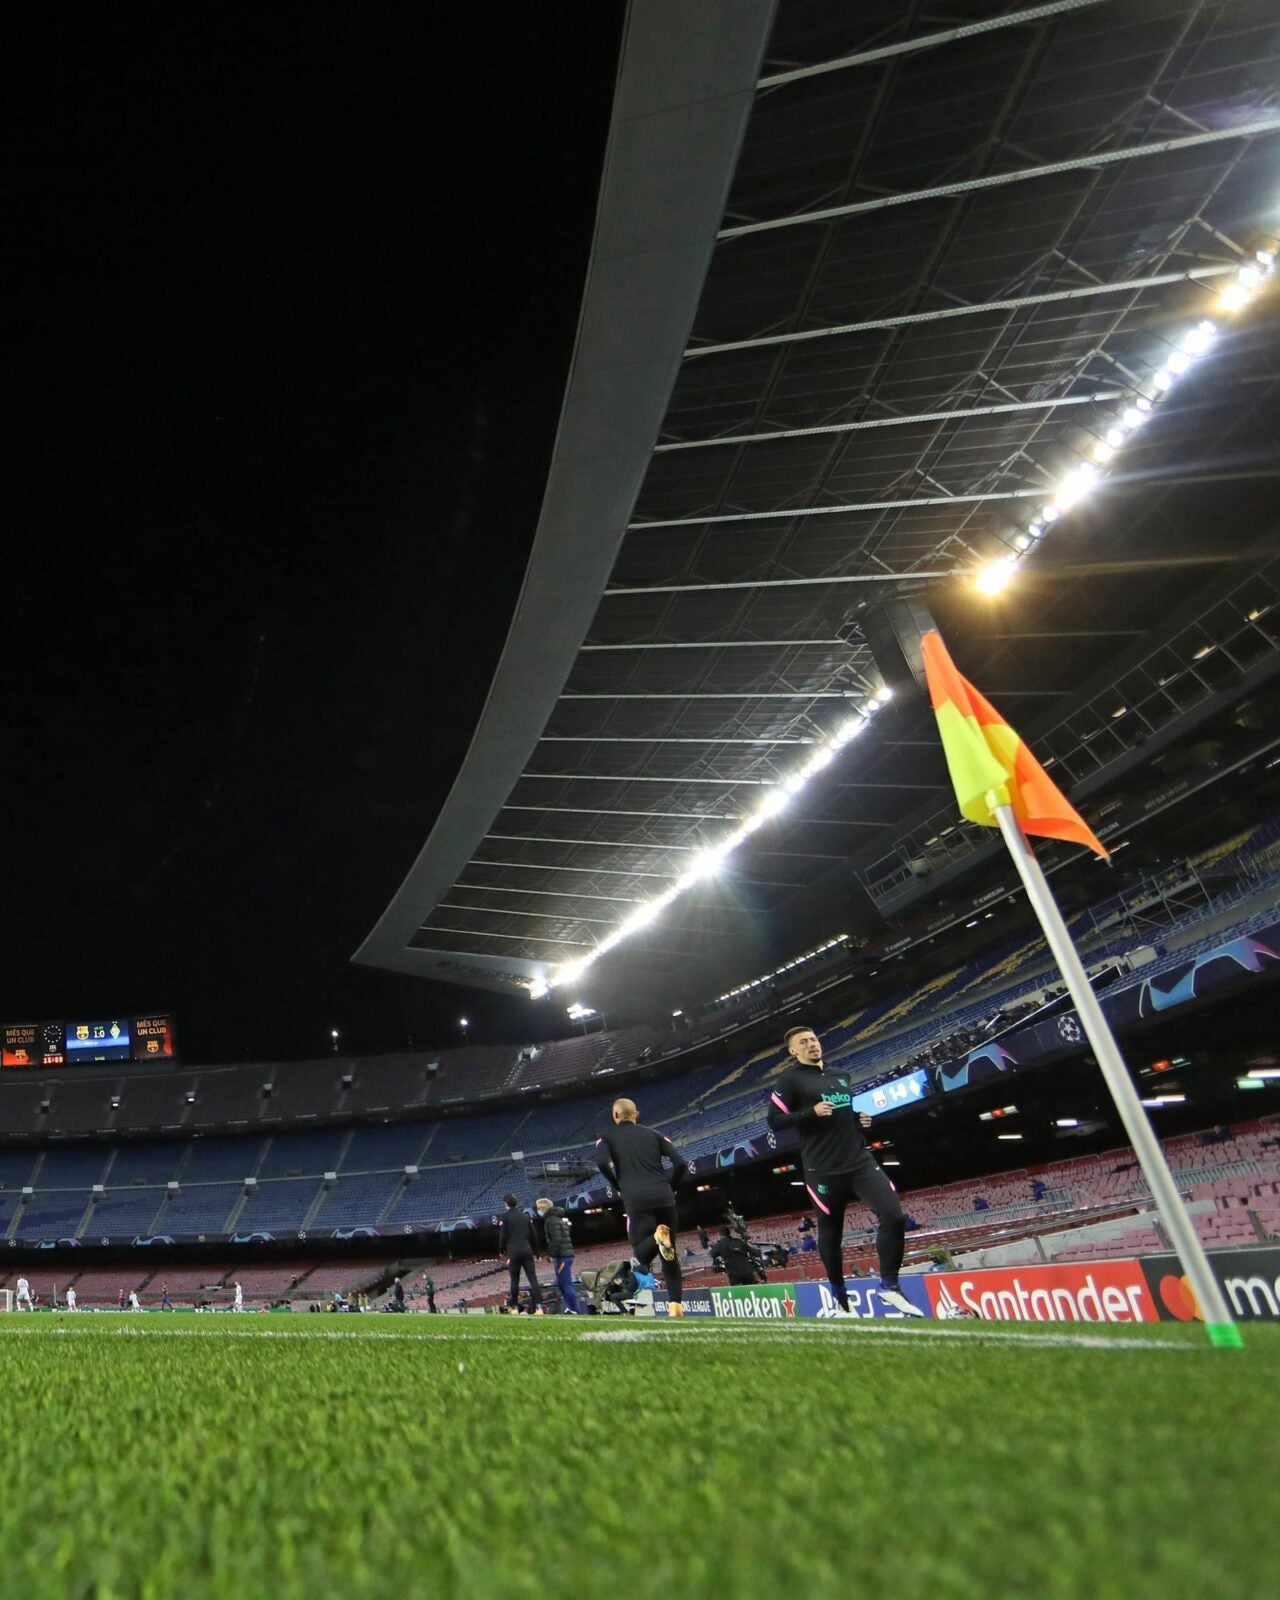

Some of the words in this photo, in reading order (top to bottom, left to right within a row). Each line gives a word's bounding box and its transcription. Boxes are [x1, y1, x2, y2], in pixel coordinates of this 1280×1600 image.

[152, 1019, 166, 1027] QUE
[148, 1027, 167, 1035] CLUB
[820, 1091, 851, 1103] beko
[711, 1290, 783, 1318] Heineken
[960, 1274, 1144, 1323] Santander
[690, 1300, 712, 1313] LEAGUE
